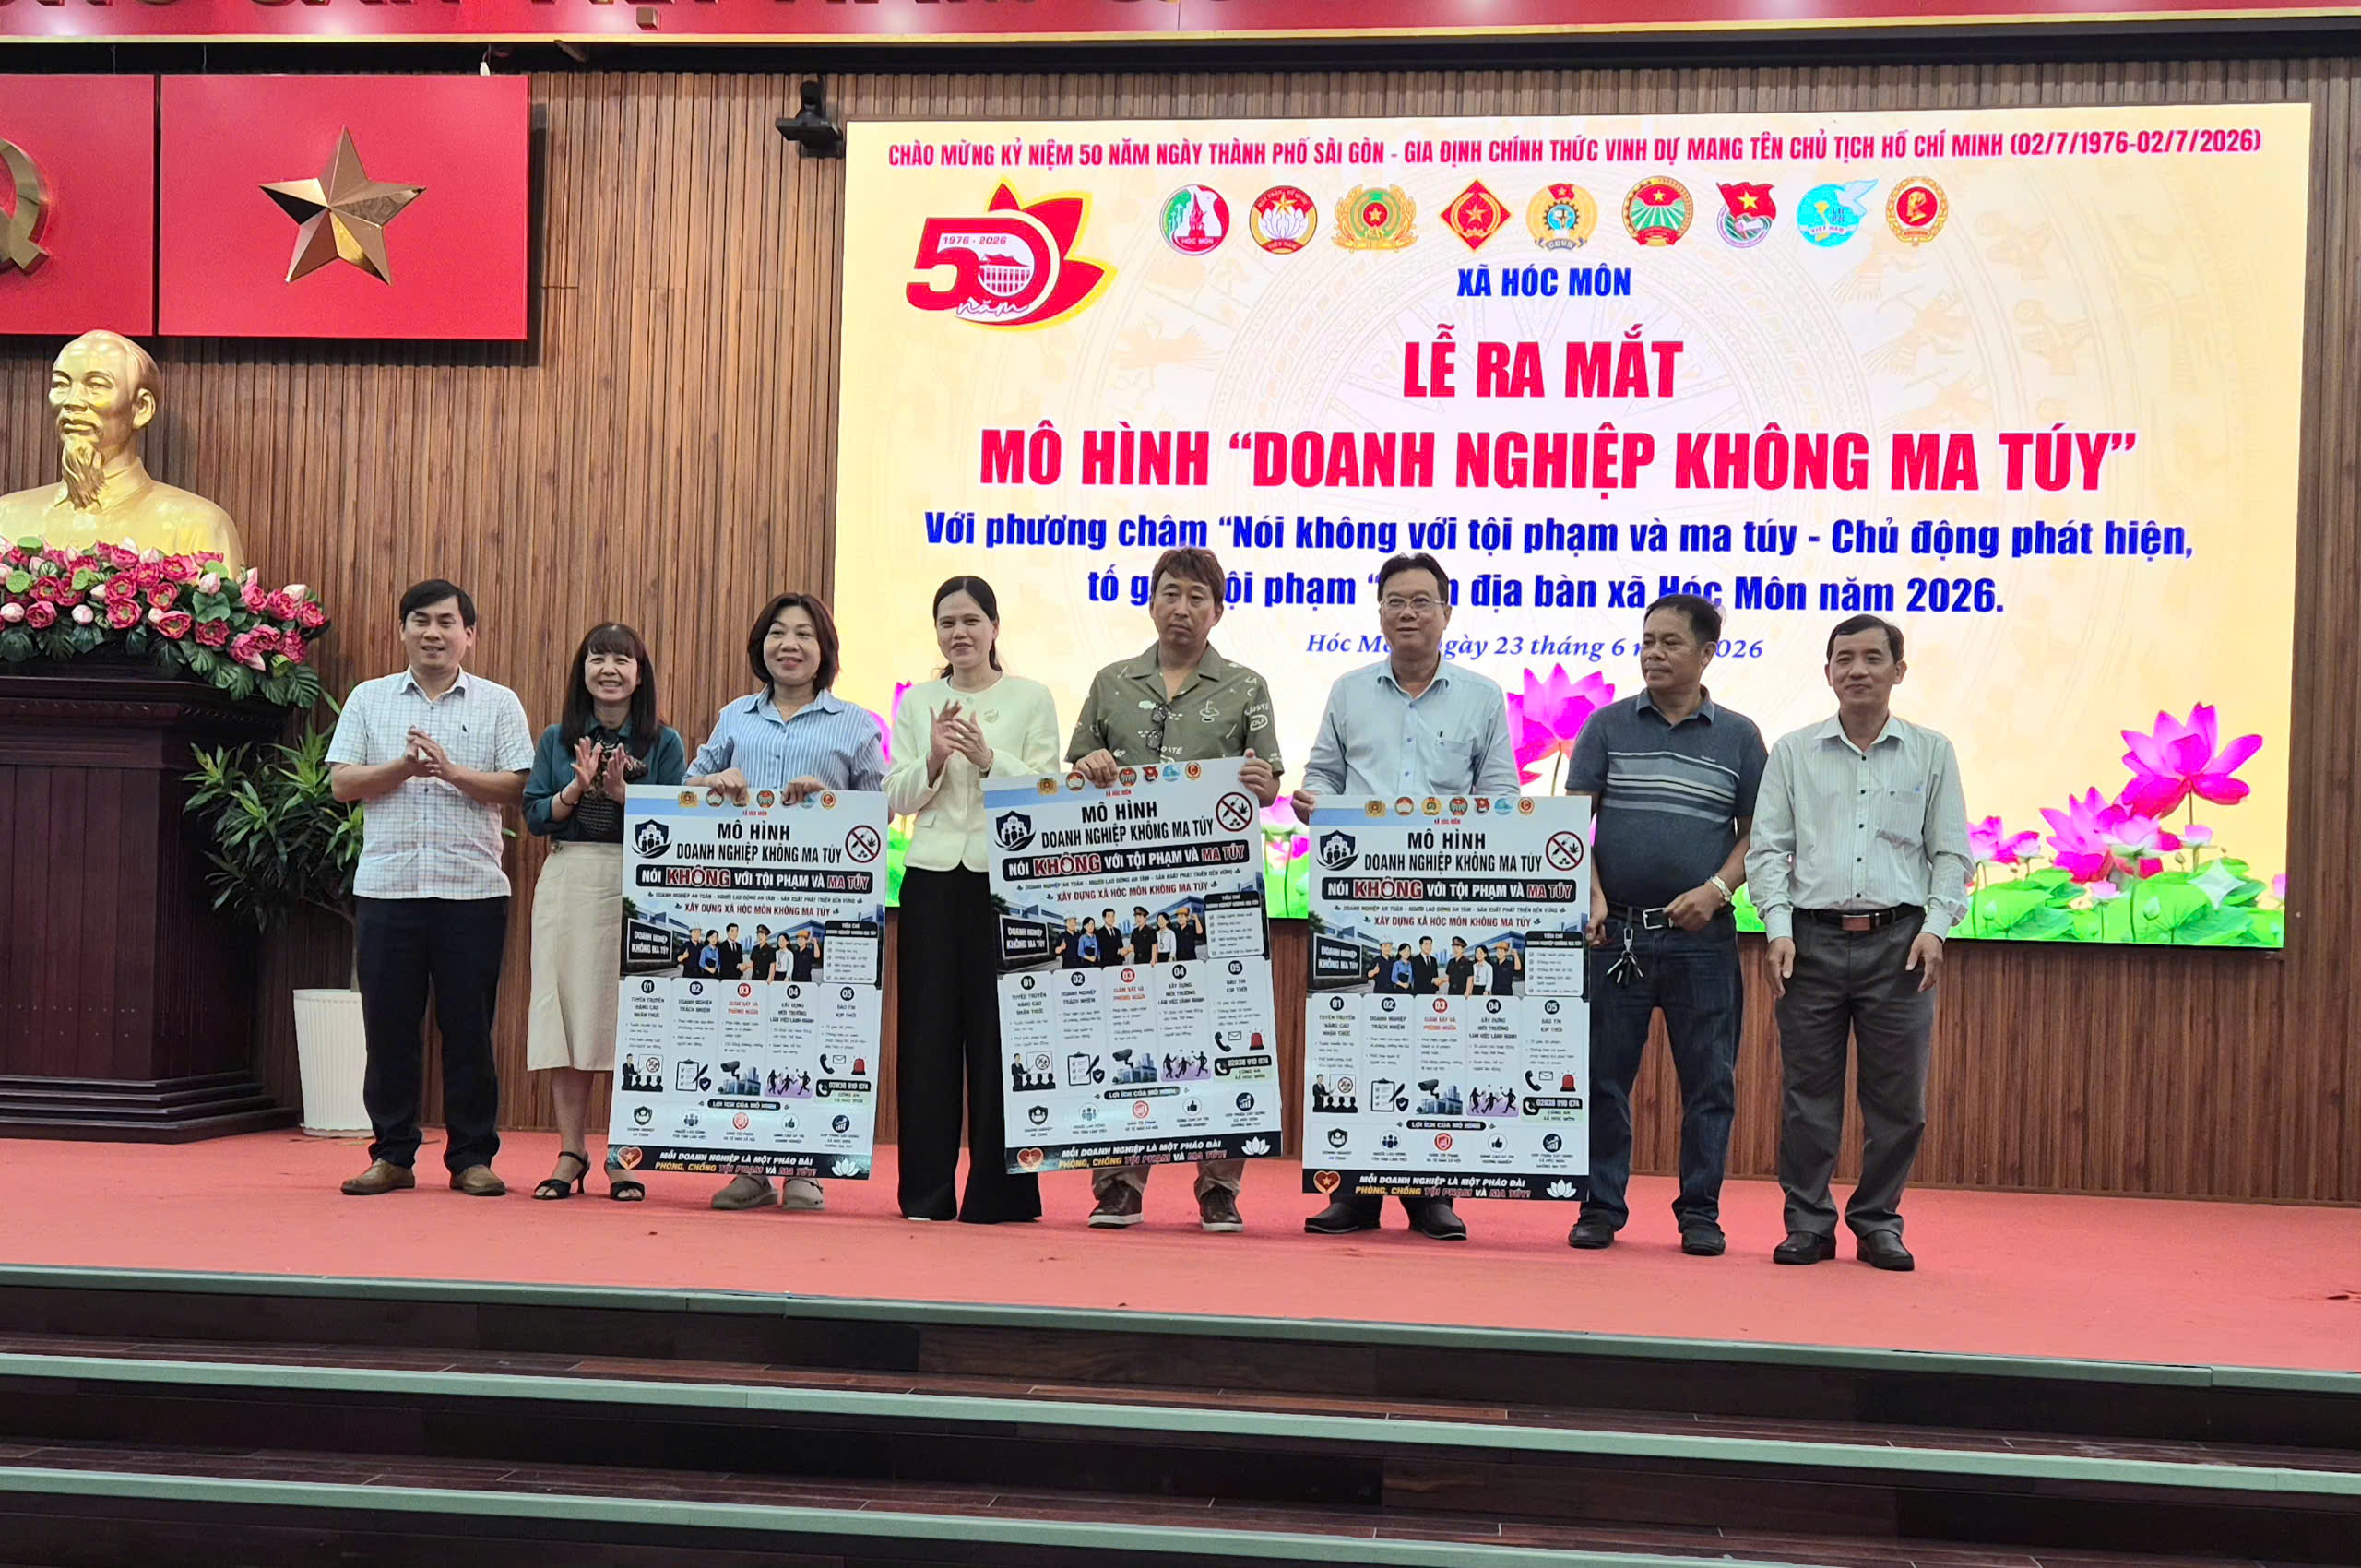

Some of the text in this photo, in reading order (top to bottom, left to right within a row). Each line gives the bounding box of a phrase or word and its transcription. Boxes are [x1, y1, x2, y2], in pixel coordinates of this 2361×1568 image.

[889, 140, 934, 166] CHÀO
[941, 139, 995, 166] MỪNG
[1002, 137, 1022, 166] KỶ
[1028, 139, 1074, 171] NIỆM
[1079, 144, 1103, 166] 50
[1109, 138, 1150, 166] NĂM
[1157, 139, 1202, 165] NGÀY
[1209, 138, 1266, 165] THÀNH
[1272, 136, 1308, 165] PHỐ
[1313, 138, 1343, 164] SÀI
[1348, 137, 1384, 164] GÒN
[1405, 141, 1433, 163] GIA
[1440, 141, 1482, 169] ĐỊNH
[1489, 136, 1544, 163] CHÍNH
[1550, 135, 1598, 162] THỨC
[1605, 139, 1647, 161] VINH
[1654, 137, 1680, 166] DỰ
[1687, 137, 1743, 160] MANG
[1750, 132, 1783, 160] TÊN
[1789, 129, 1827, 160] CHỦ
[1833, 136, 1875, 163] TỊCH
[1881, 131, 1906, 159] HỒ
[1914, 130, 1946, 158] CHÍ
[1952, 134, 2003, 157] MINH
[2010, 129, 2261, 156] (02/7/1976-02/7/2026)
[943, 236, 969, 244] 1976
[979, 236, 1007, 244] 2026
[1456, 262, 1631, 297] XÃ HÓC MÔN
[1403, 323, 1684, 398] LỄ RA MẮT
[980, 420, 2136, 499] MÔ HÌNH “DOANH NGHIỆP KHÔNG MA TÚY”
[925, 512, 975, 545] Với
[986, 513, 1107, 551] phương
[1118, 514, 1207, 548] châm
[1218, 516, 1285, 549] “Nói
[1296, 516, 1397, 554] không
[1408, 517, 1457, 551] với
[1467, 517, 1513, 556] tội
[1524, 517, 1619, 558] phạm
[1630, 517, 1668, 552] và
[1679, 524, 1732, 552] ma
[1743, 518, 1797, 556] túy
[1832, 517, 1899, 554] Chủ
[1911, 520, 1999, 561] động
[2011, 520, 2094, 558] phát
[2105, 520, 2192, 562] hiện,
[1088, 564, 1119, 602] tố
[1224, 571, 1253, 610] ội
[1264, 572, 1357, 612] phạm
[1470, 574, 1523, 613] địa
[1534, 574, 1597, 608] bàn
[1608, 576, 1646, 609] xã
[1734, 576, 1807, 611] Môn
[1819, 577, 1894, 612] năm
[1906, 577, 2004, 613] 2026.
[1307, 632, 1349, 653] Hóc
[1442, 633, 1488, 660] gày
[1494, 636, 1524, 656] 23
[1530, 635, 1605, 662] tháng
[1611, 638, 1626, 658] 6
[1714, 639, 1763, 659] 026
[1082, 799, 1157, 823] MÔ HÌNH
[718, 819, 789, 841] MÔ HÌNH
[1042, 815, 1213, 849] DOANH NGHIỆP KHÔNG MA TÚY
[1408, 828, 1486, 849] MÔ HÌNH
[677, 842, 841, 864] DOANH NGHIỆP KHÔNG MA TÚY
[1009, 860, 1029, 876] NÓI
[1033, 852, 1101, 876] KHÔNG
[1105, 852, 1123, 869] VỚI
[1126, 851, 1145, 870] TỘI
[1149, 849, 1181, 867] PHẠM
[1184, 847, 1199, 862] VÀ
[1202, 848, 1221, 861] MA
[1365, 851, 1542, 874] DOANH NGHIỆP KHÔNG MA TÚY
[642, 868, 661, 883] NÓI
[666, 864, 730, 886] KHÔNG
[734, 871, 753, 885] VỚI
[756, 872, 773, 889] TỘI
[777, 874, 808, 889] PHẠM
[812, 873, 825, 888] VÀ
[827, 875, 845, 889] MA
[1328, 880, 1348, 896] NÓI
[1353, 876, 1423, 898] KHÔNG
[1427, 881, 1446, 897] VỚI
[1449, 881, 1468, 900] TỘI
[1472, 885, 1507, 900] PHẠM
[1510, 882, 1525, 897] VÀ
[1527, 884, 1547, 898] MA
